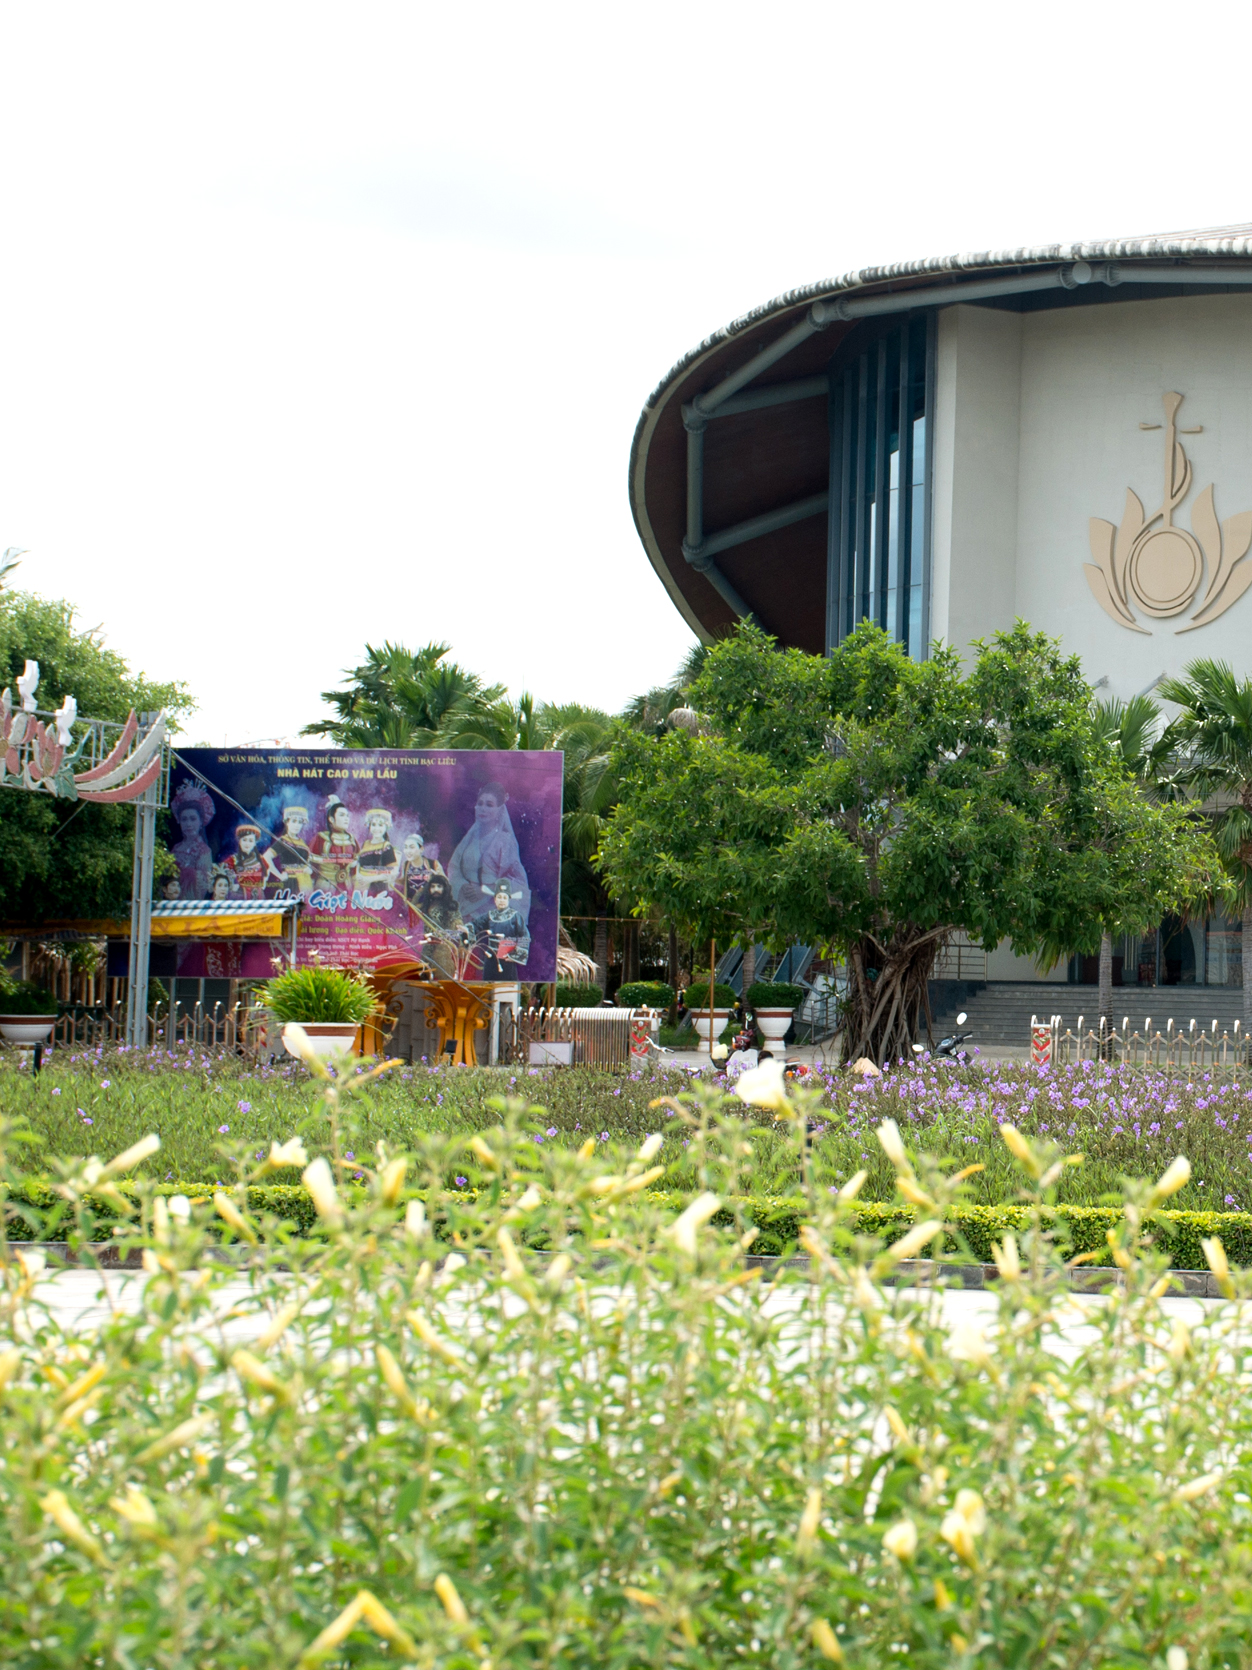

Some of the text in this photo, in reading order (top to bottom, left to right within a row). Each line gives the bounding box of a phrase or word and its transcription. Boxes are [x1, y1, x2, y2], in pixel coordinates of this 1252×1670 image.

[230, 754, 246, 763] VĂN
[268, 755, 296, 764] THÔNG
[379, 757, 398, 766] LỊCH
[438, 756, 457, 765] LIÊU
[277, 767, 398, 779] NHÀ HÁT CAO VĂN LẦU
[309, 889, 347, 913] Giọt
[350, 889, 393, 910] Nước
